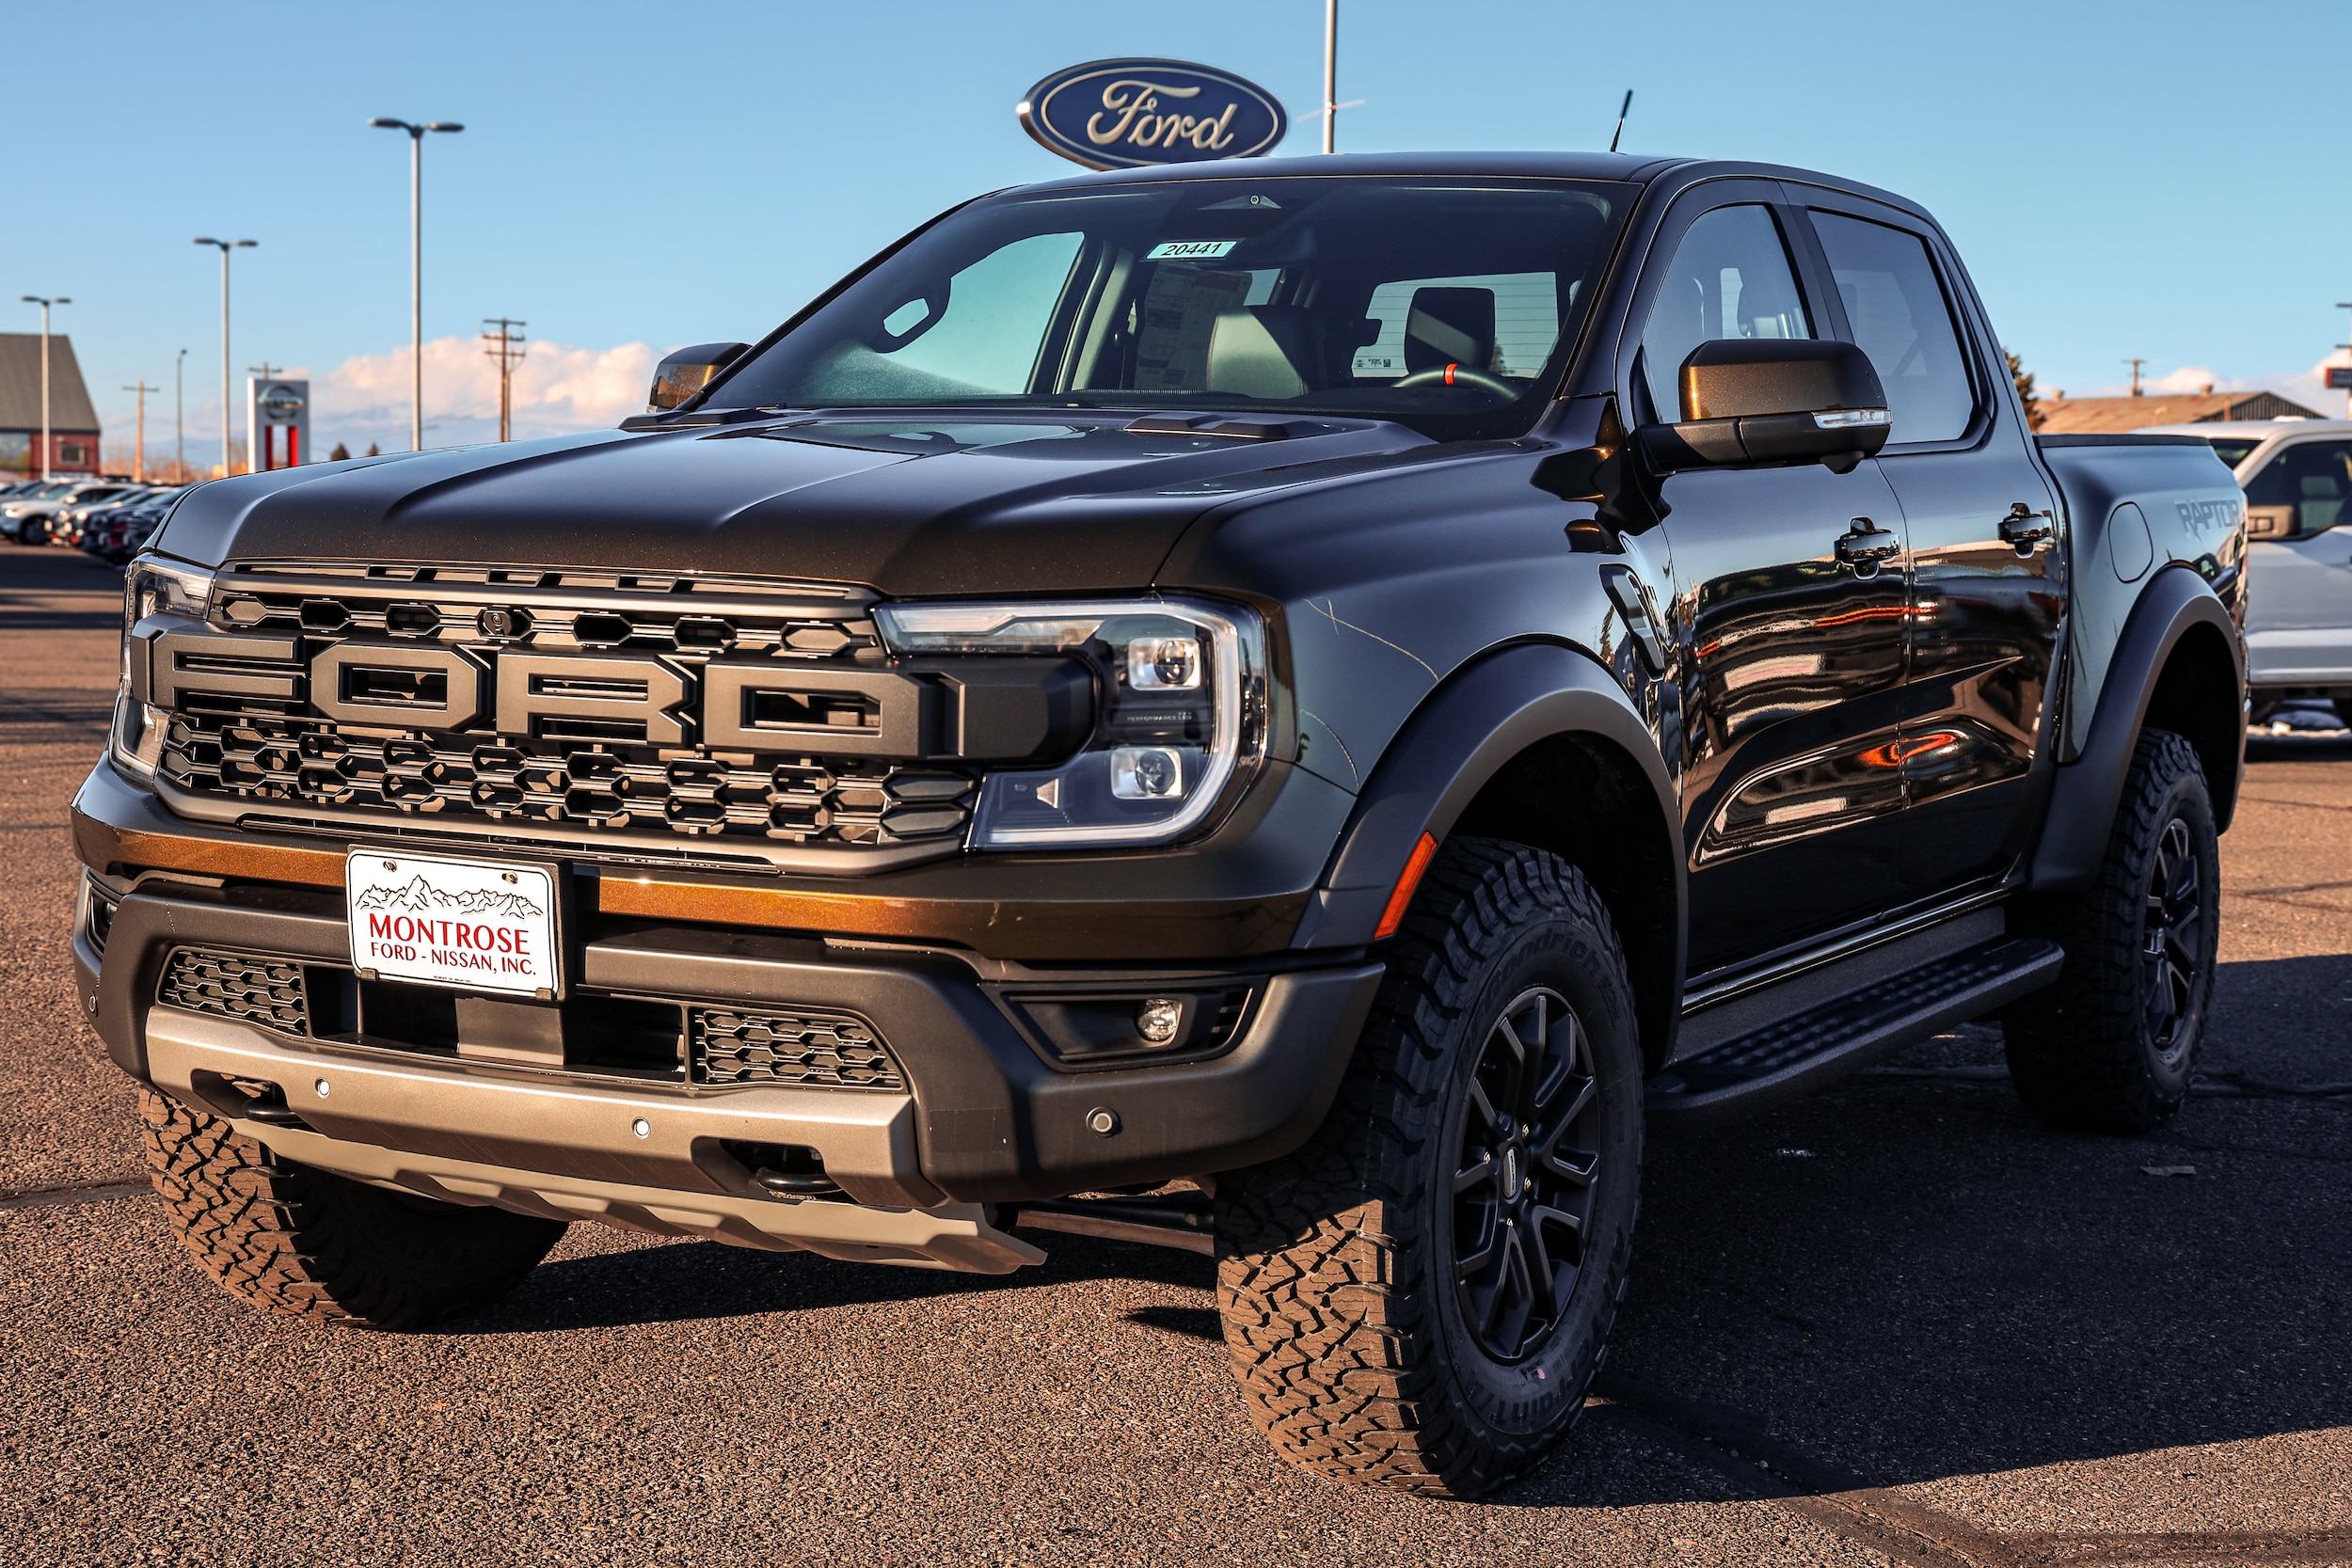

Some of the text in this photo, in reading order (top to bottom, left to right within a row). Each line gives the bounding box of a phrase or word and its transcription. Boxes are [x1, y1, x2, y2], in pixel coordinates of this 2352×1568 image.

[1087, 79, 1239, 150] Ford
[1160, 243, 1222, 257] 20441
[2174, 499, 2244, 543] RAPTOR
[152, 631, 921, 756] FORD
[1127, 714, 1176, 722] PERFORMANCE
[369, 912, 531, 956] MONTROSE
[371, 942, 417, 962] FORD
[431, 948, 498, 974] NISSAN,
[501, 956, 537, 976] INC.
